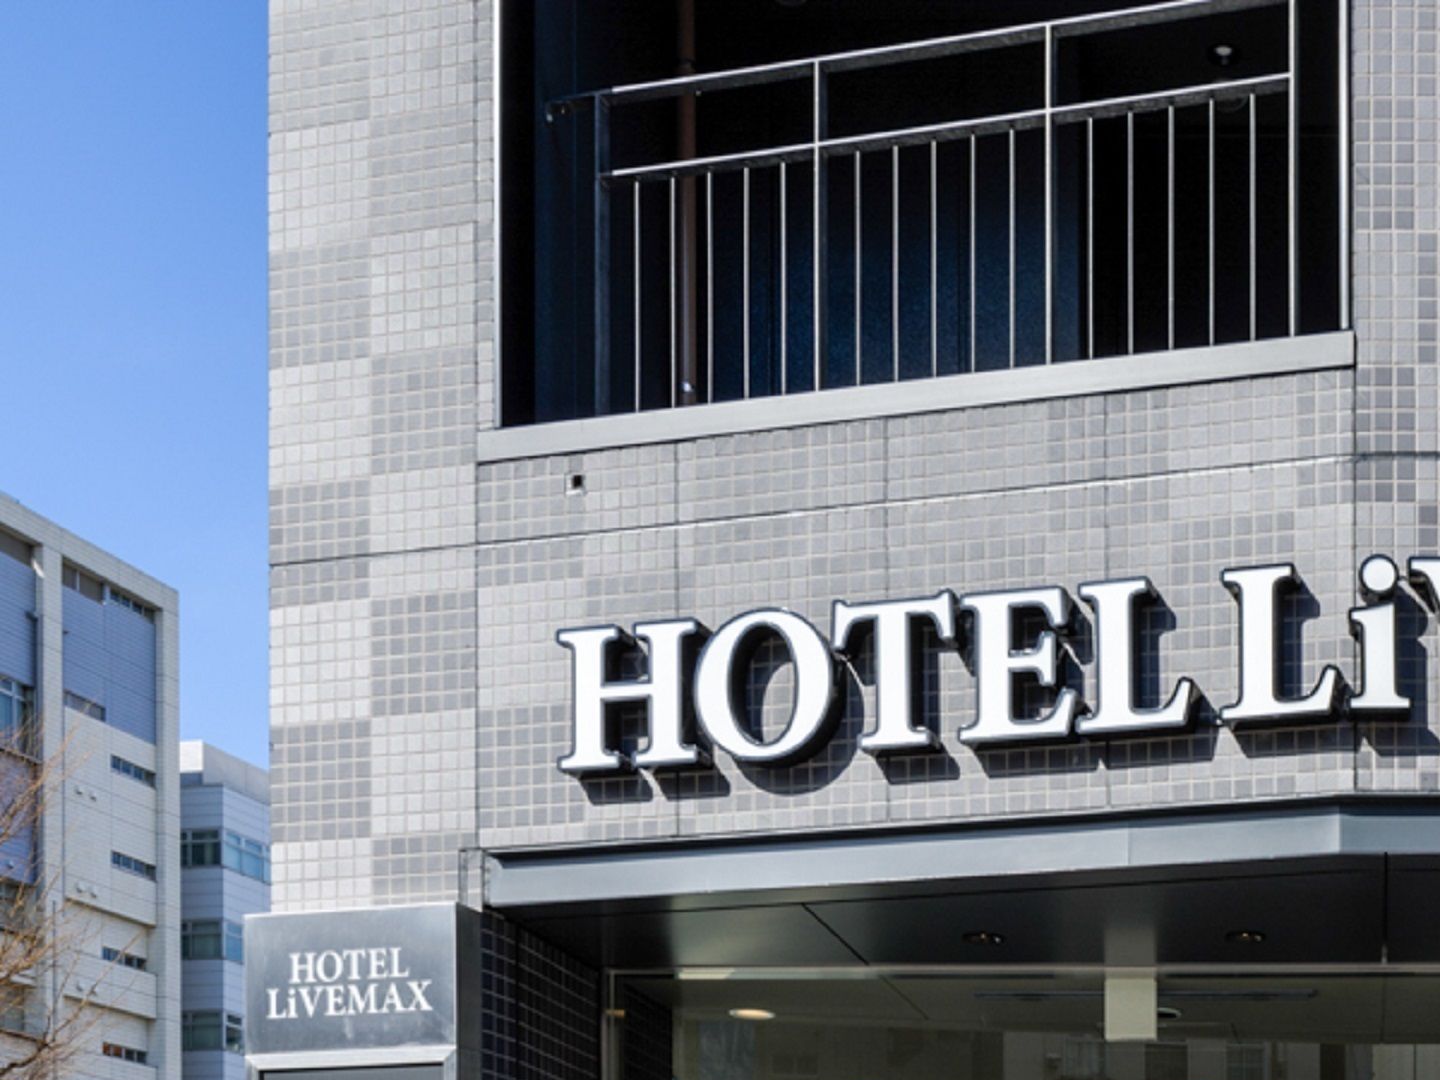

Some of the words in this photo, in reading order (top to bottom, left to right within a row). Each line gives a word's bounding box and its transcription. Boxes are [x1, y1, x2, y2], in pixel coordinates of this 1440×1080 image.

[556, 577, 1196, 773] HOTEL
[289, 947, 410, 984] HOTEL
[266, 979, 433, 1020] LiVEMAX
